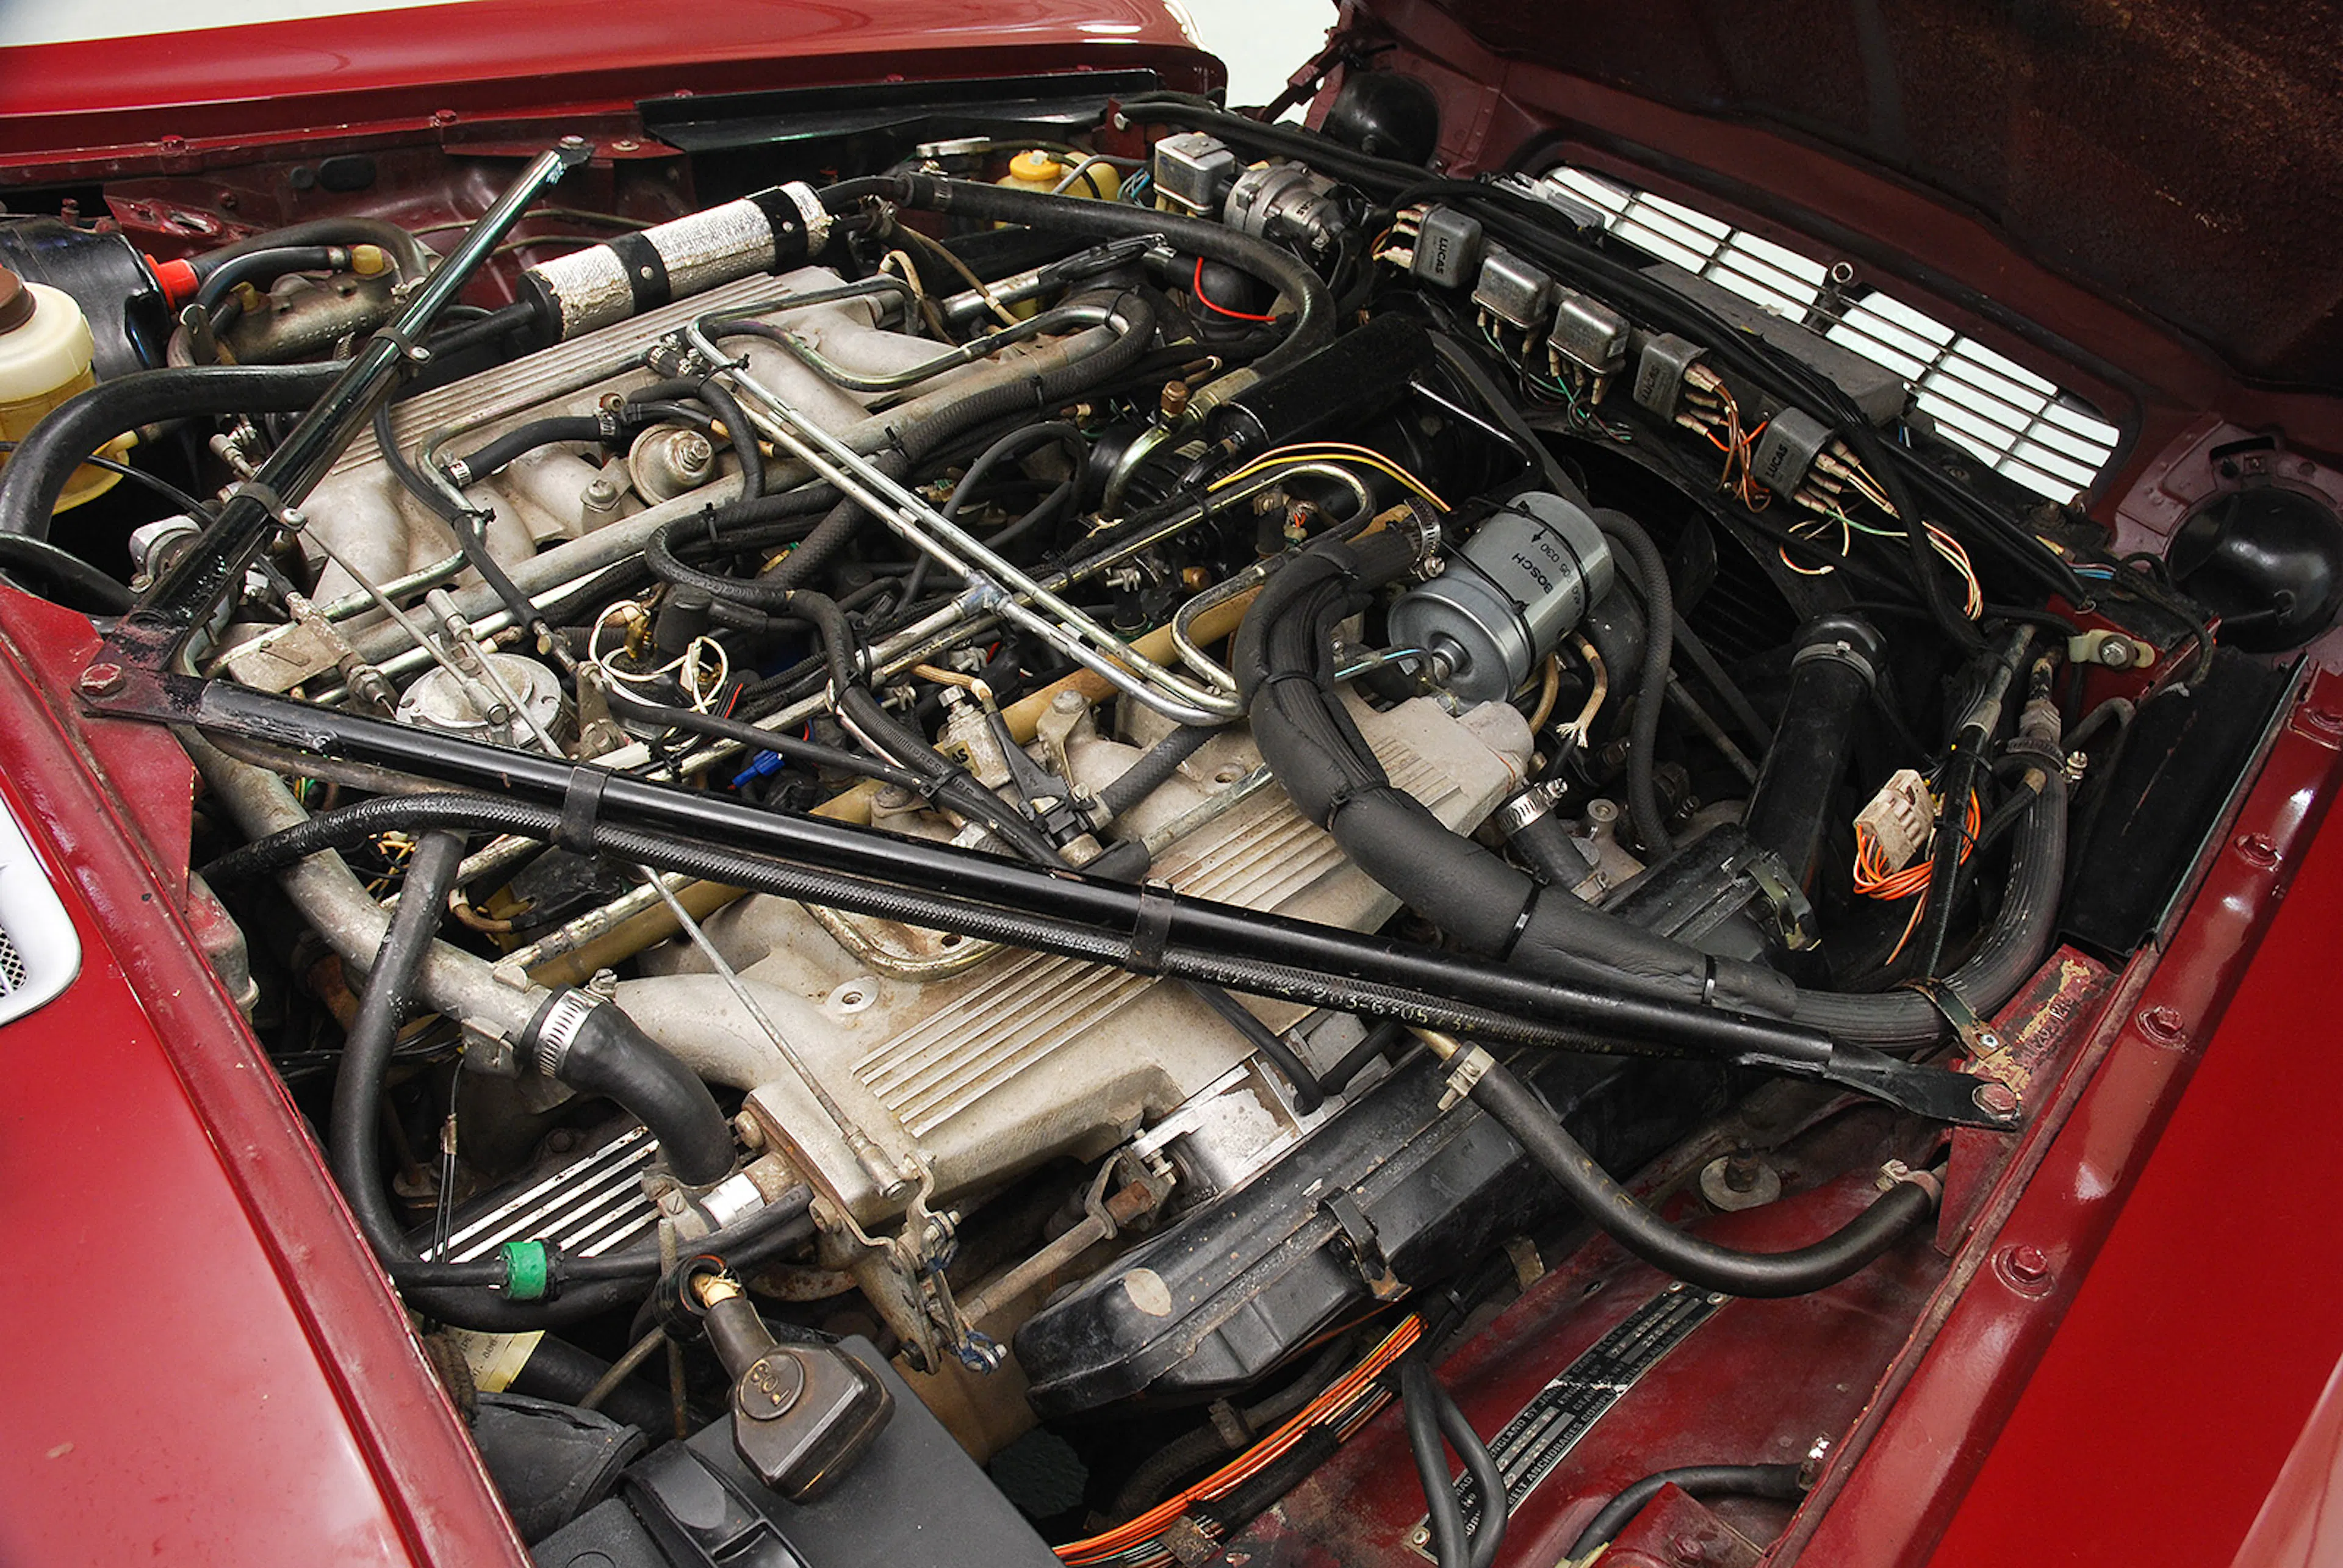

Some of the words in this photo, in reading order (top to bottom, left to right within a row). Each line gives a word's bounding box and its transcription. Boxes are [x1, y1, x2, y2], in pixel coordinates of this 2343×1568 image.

[1435, 237, 1447, 275] LUCAS
[1638, 362, 1660, 403] LUCAS
[1764, 442, 1788, 478] LUCAS
[1510, 551, 1555, 595] BOSCH
[1539, 542, 1560, 564] 030
[747, 1360, 790, 1406] POS
[1524, 1405, 1539, 1420] BY
[1571, 1350, 1598, 1376] CARS
[1525, 1420, 1585, 1483] ANCHORAGES
